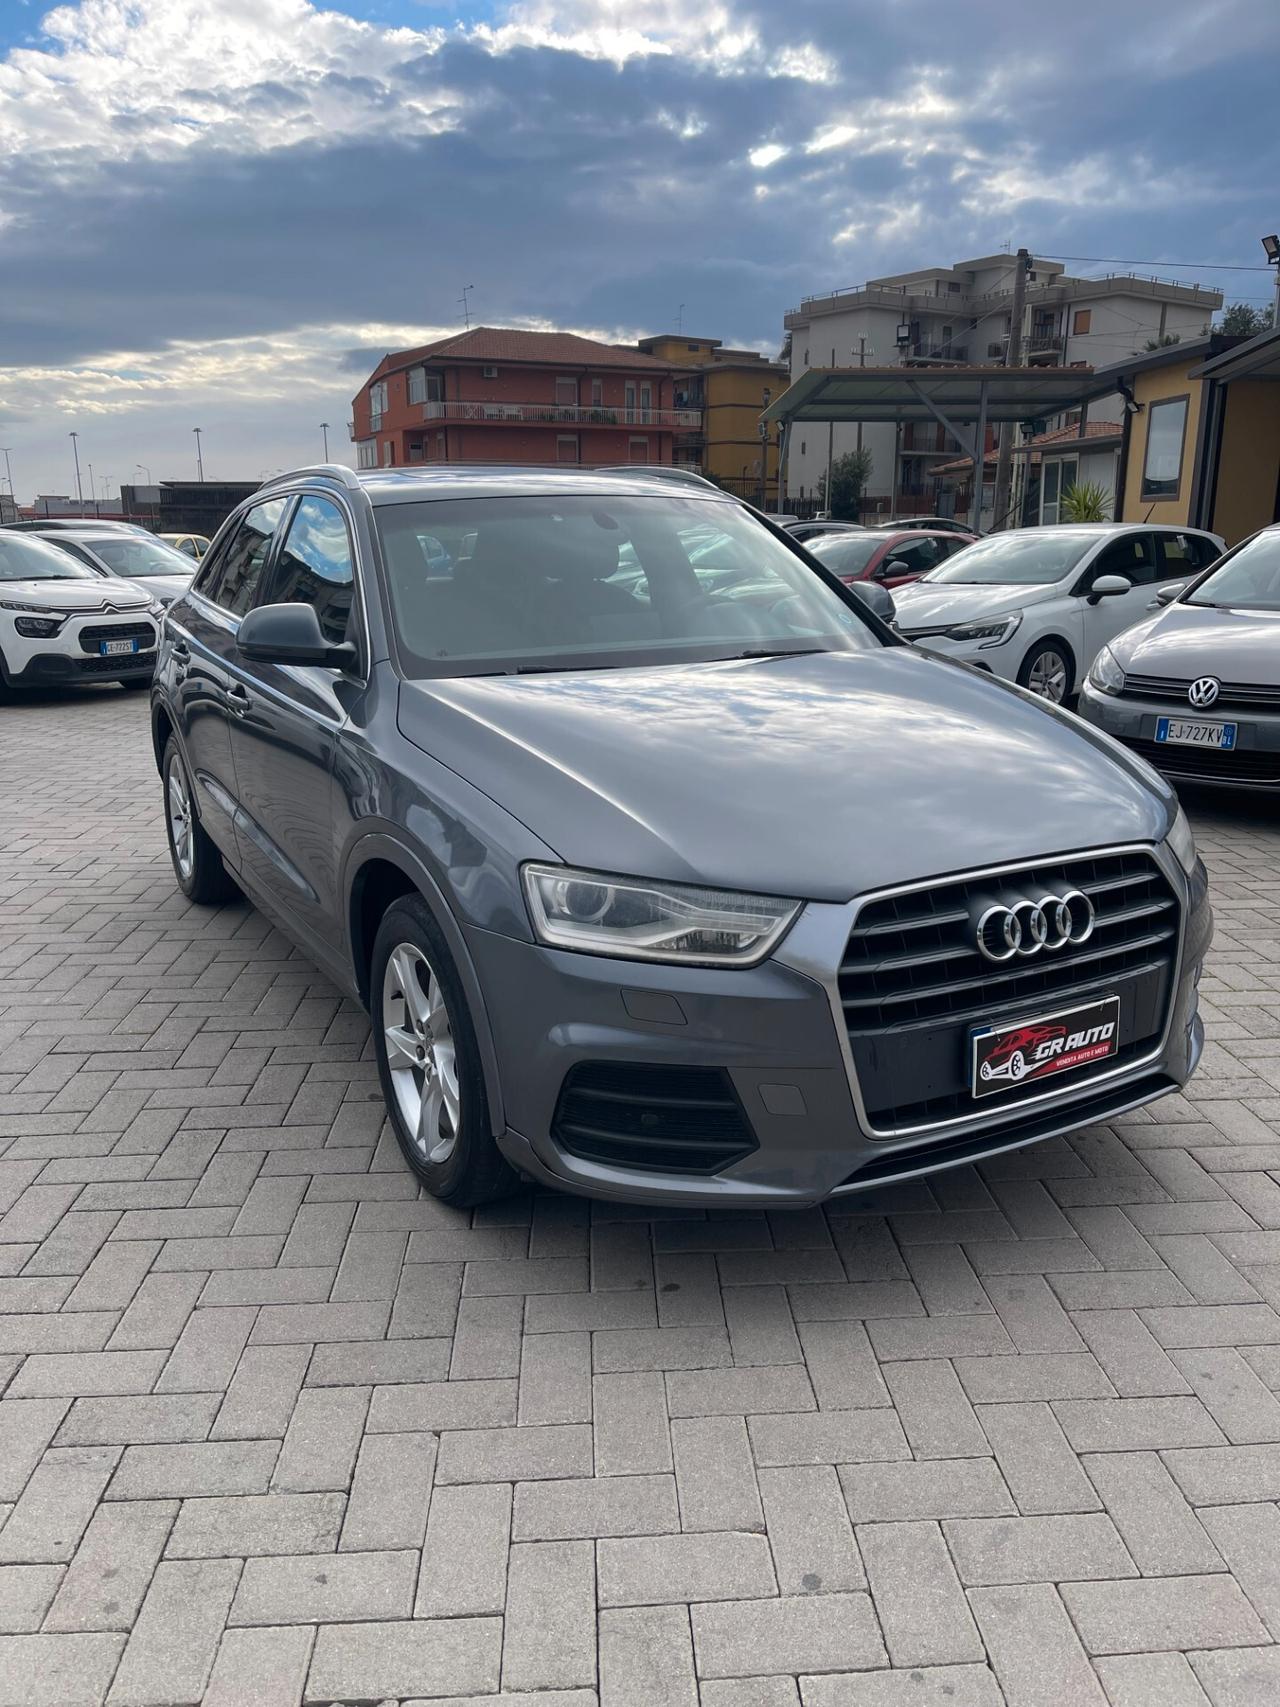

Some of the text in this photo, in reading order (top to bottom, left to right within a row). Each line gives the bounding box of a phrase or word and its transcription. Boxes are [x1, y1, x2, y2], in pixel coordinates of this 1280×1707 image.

[1033, 1022, 1115, 1060] GR AUTO
[1077, 1051, 1091, 1060] AUTO
[1094, 1046, 1109, 1055] MOTO
